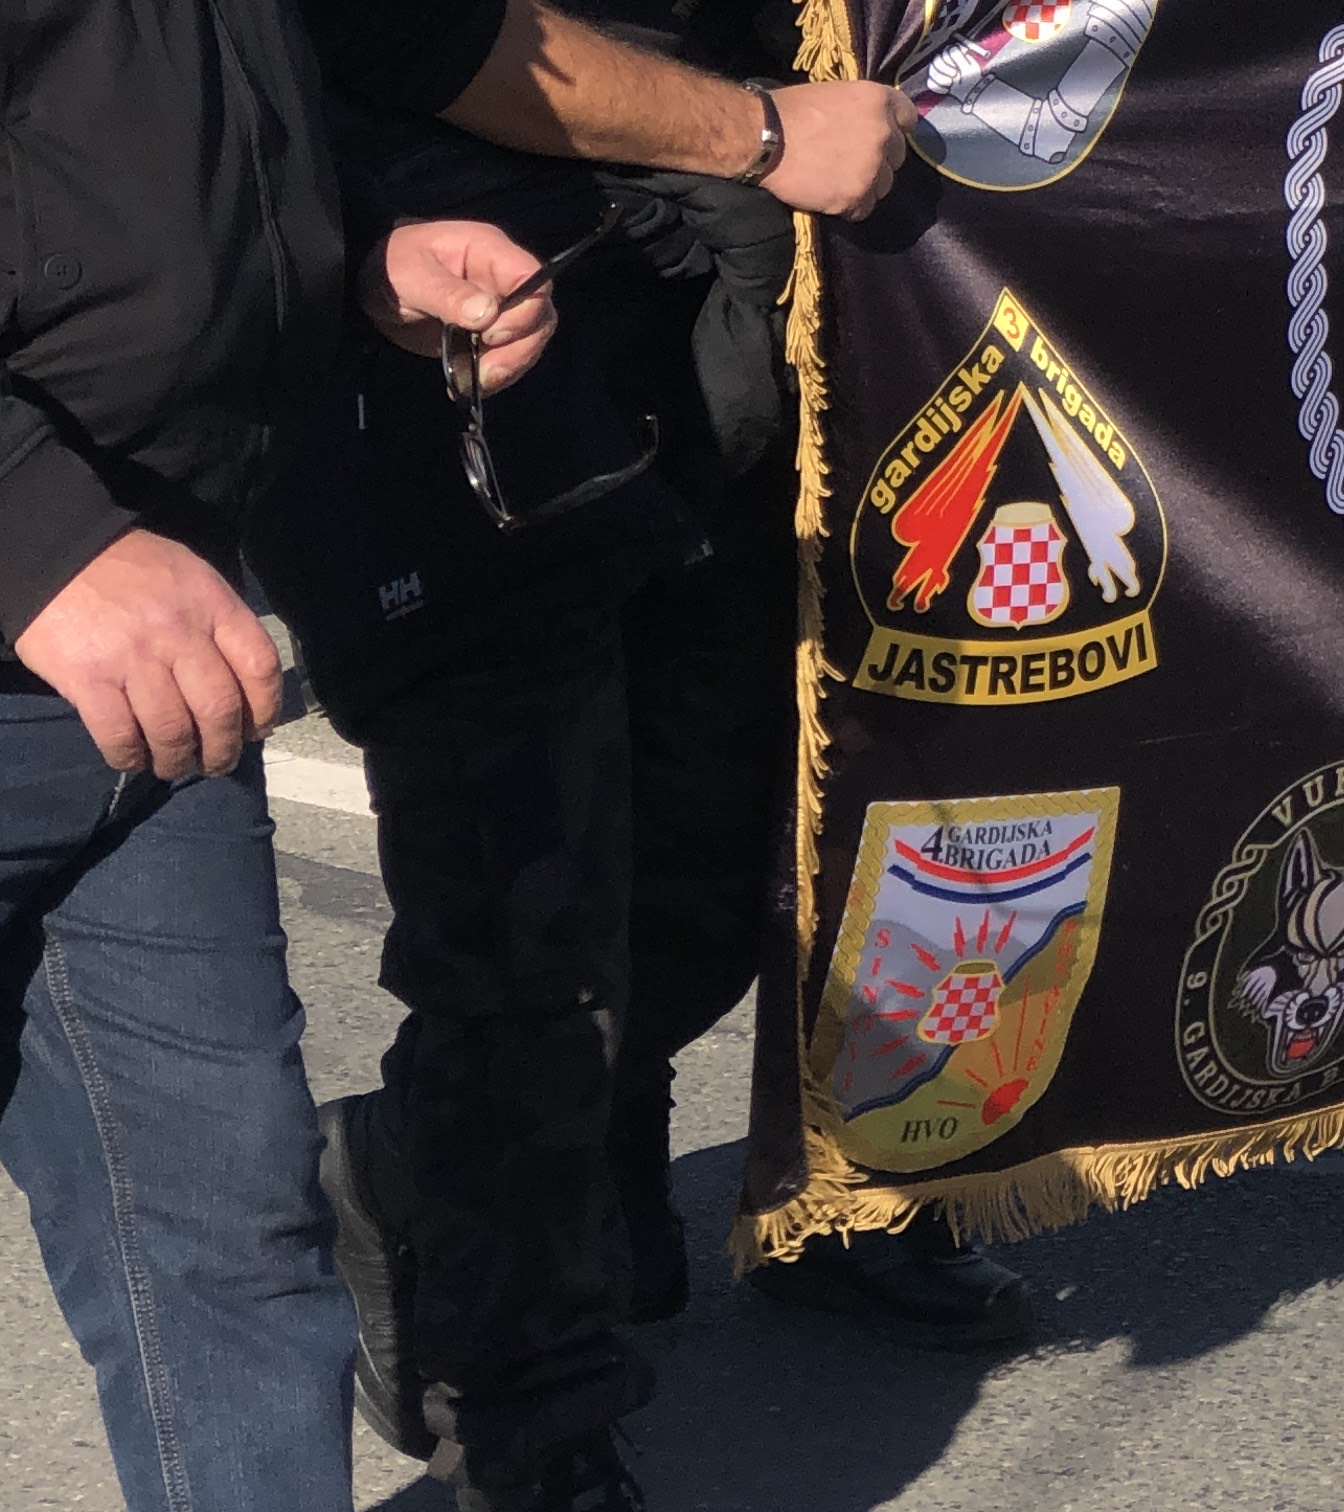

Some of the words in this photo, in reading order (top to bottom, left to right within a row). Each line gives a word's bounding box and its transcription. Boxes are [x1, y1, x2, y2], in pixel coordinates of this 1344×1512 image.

[1002, 306, 1021, 340] 3
[869, 343, 1006, 515] gardijska
[1029, 336, 1128, 471] brigada
[867, 624, 1150, 696] JASTREBOVI
[944, 840, 1051, 870] BRIGADA
[948, 820, 1053, 845] GARDIJSKA
[1183, 1020, 1301, 1109] GARDIJSKA
[901, 1116, 958, 1144] HVO
